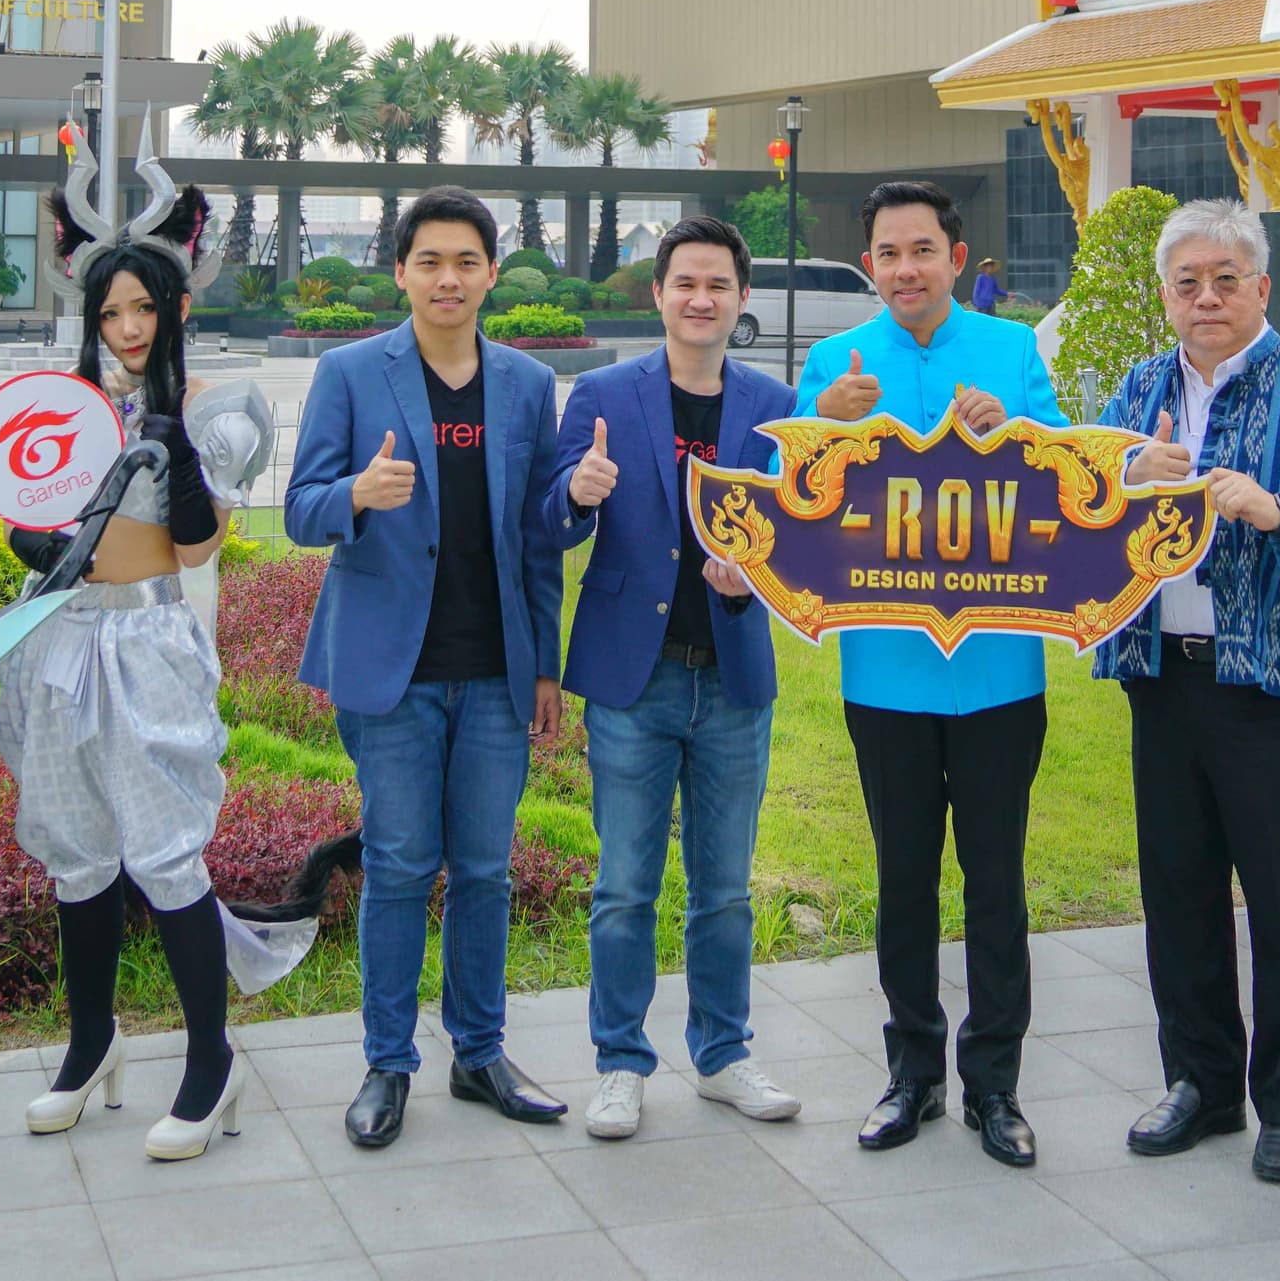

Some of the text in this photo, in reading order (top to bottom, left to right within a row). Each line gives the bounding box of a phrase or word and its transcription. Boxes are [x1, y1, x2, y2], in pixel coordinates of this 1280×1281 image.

[17, 471, 94, 508] Garena
[851, 569, 1048, 594] DESIGN CONTEST
